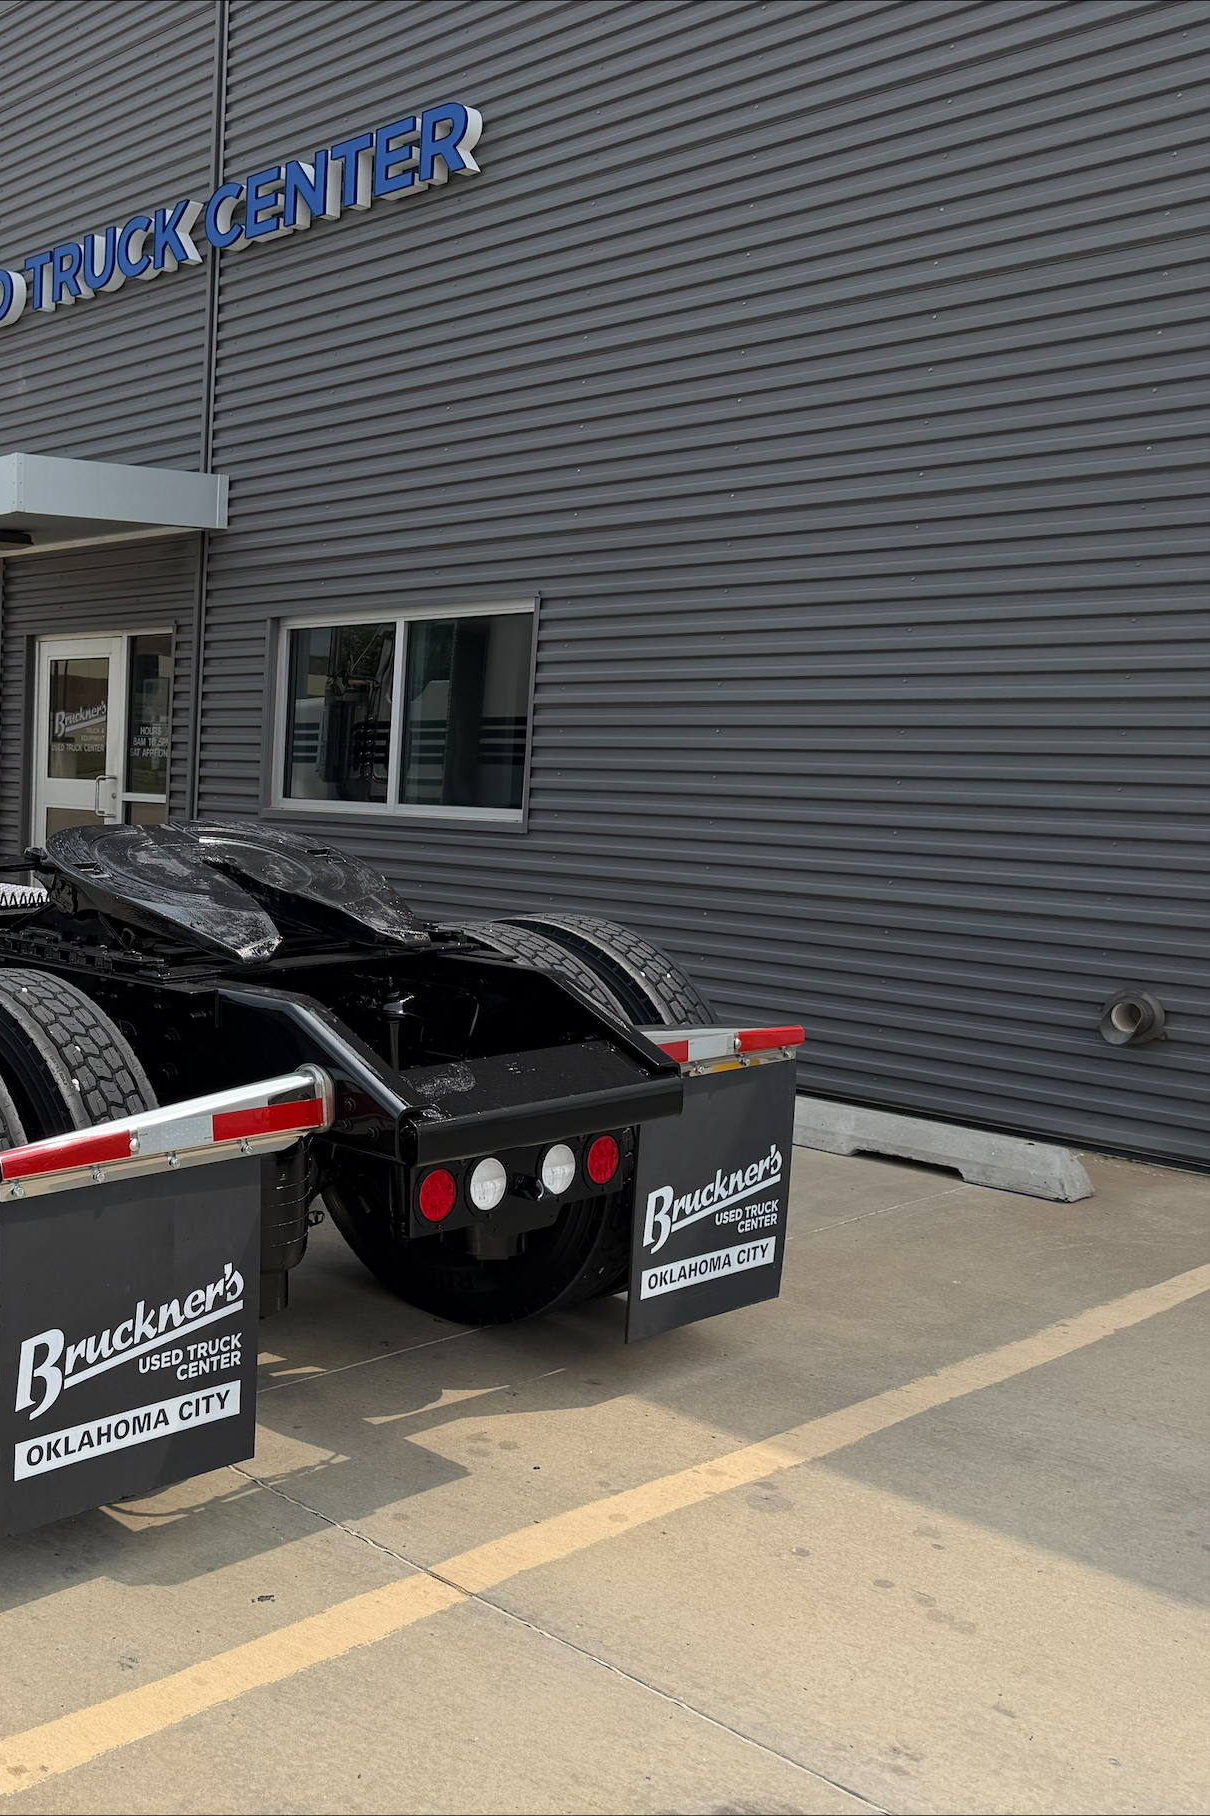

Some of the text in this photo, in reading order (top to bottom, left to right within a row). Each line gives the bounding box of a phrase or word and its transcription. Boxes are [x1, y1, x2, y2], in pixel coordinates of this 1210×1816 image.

[25, 200, 199, 310] TRUCK
[205, 102, 480, 250] CENTER
[54, 700, 107, 738] Bruckner's
[140, 726, 162, 736] HOURS
[51, 743, 105, 752] USED TRUCK CENTER
[642, 1143, 783, 1255] Bruckner's
[714, 1199, 779, 1226] USED TRUCK
[737, 1213, 778, 1234] CENTER
[647, 1243, 770, 1290] OKLAHOMA CITY
[14, 1262, 245, 1421] Bruckner's
[138, 1333, 243, 1375] USED TRUCK
[176, 1351, 242, 1381] CENTER
[26, 1388, 232, 1467] OKLAHOMA CITY
